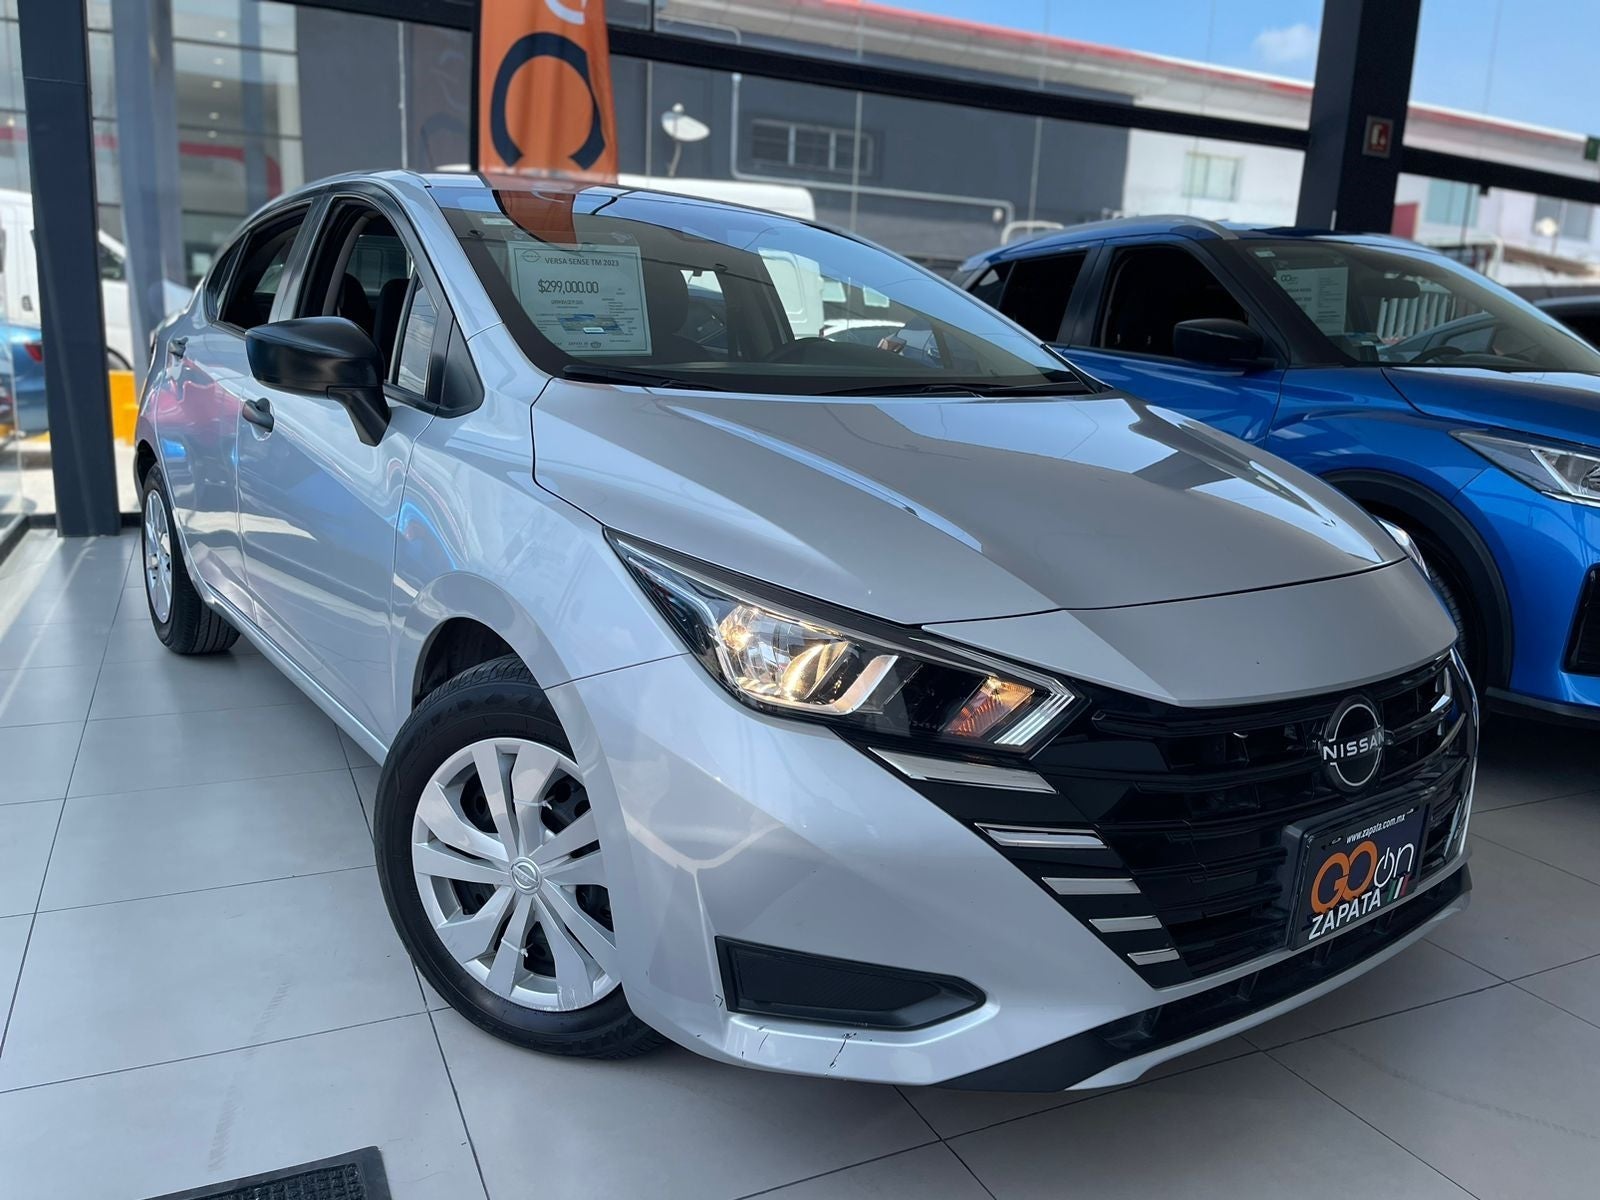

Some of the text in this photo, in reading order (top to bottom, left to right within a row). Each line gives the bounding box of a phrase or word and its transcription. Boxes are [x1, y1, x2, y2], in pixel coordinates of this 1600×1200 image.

[545, 257, 568, 265] VERSA
[569, 258, 589, 266] SENSE
[603, 259, 619, 267] 2023
[537, 278, 599, 294] $299,000.00
[1323, 731, 1385, 761] NISSAN
[1346, 814, 1406, 844] www.zapata.com.mx
[1308, 889, 1382, 941] ZAPATA
